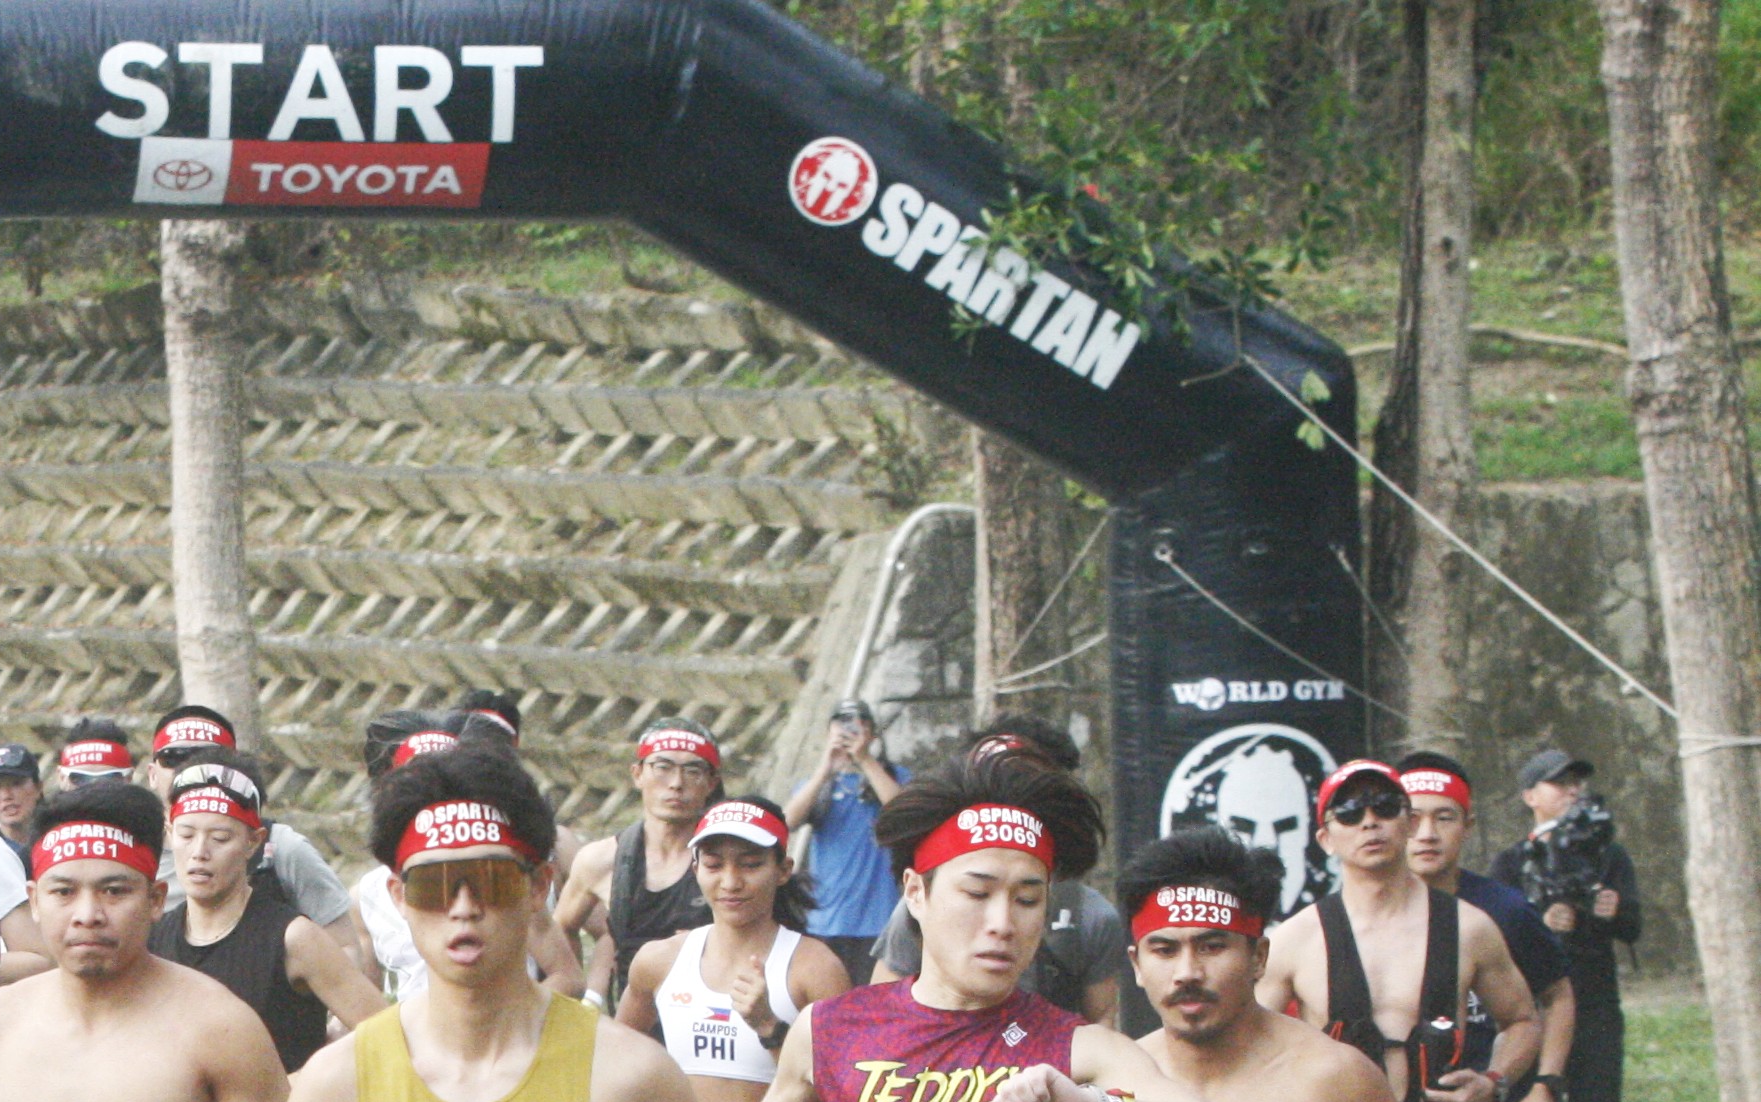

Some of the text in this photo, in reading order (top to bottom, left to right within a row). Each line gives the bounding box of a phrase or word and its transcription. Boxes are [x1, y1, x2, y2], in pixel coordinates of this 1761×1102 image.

[95, 41, 544, 142] START
[251, 163, 461, 195] TOYOTA
[862, 183, 1140, 390] SPARTAN
[1293, 680, 1344, 700] GYM
[169, 729, 213, 743] 23141
[182, 800, 229, 815] 22888
[425, 820, 501, 848] 23068
[980, 807, 1043, 838] SPARTAN
[61, 825, 134, 849] SPARTAN
[968, 824, 1037, 849] 23069
[52, 841, 119, 862] 20161
[1176, 886, 1239, 909] SPARTAN
[1168, 904, 1232, 926] 23239
[692, 1022, 737, 1037] CAMPOS
[694, 1035, 735, 1061] PHI
